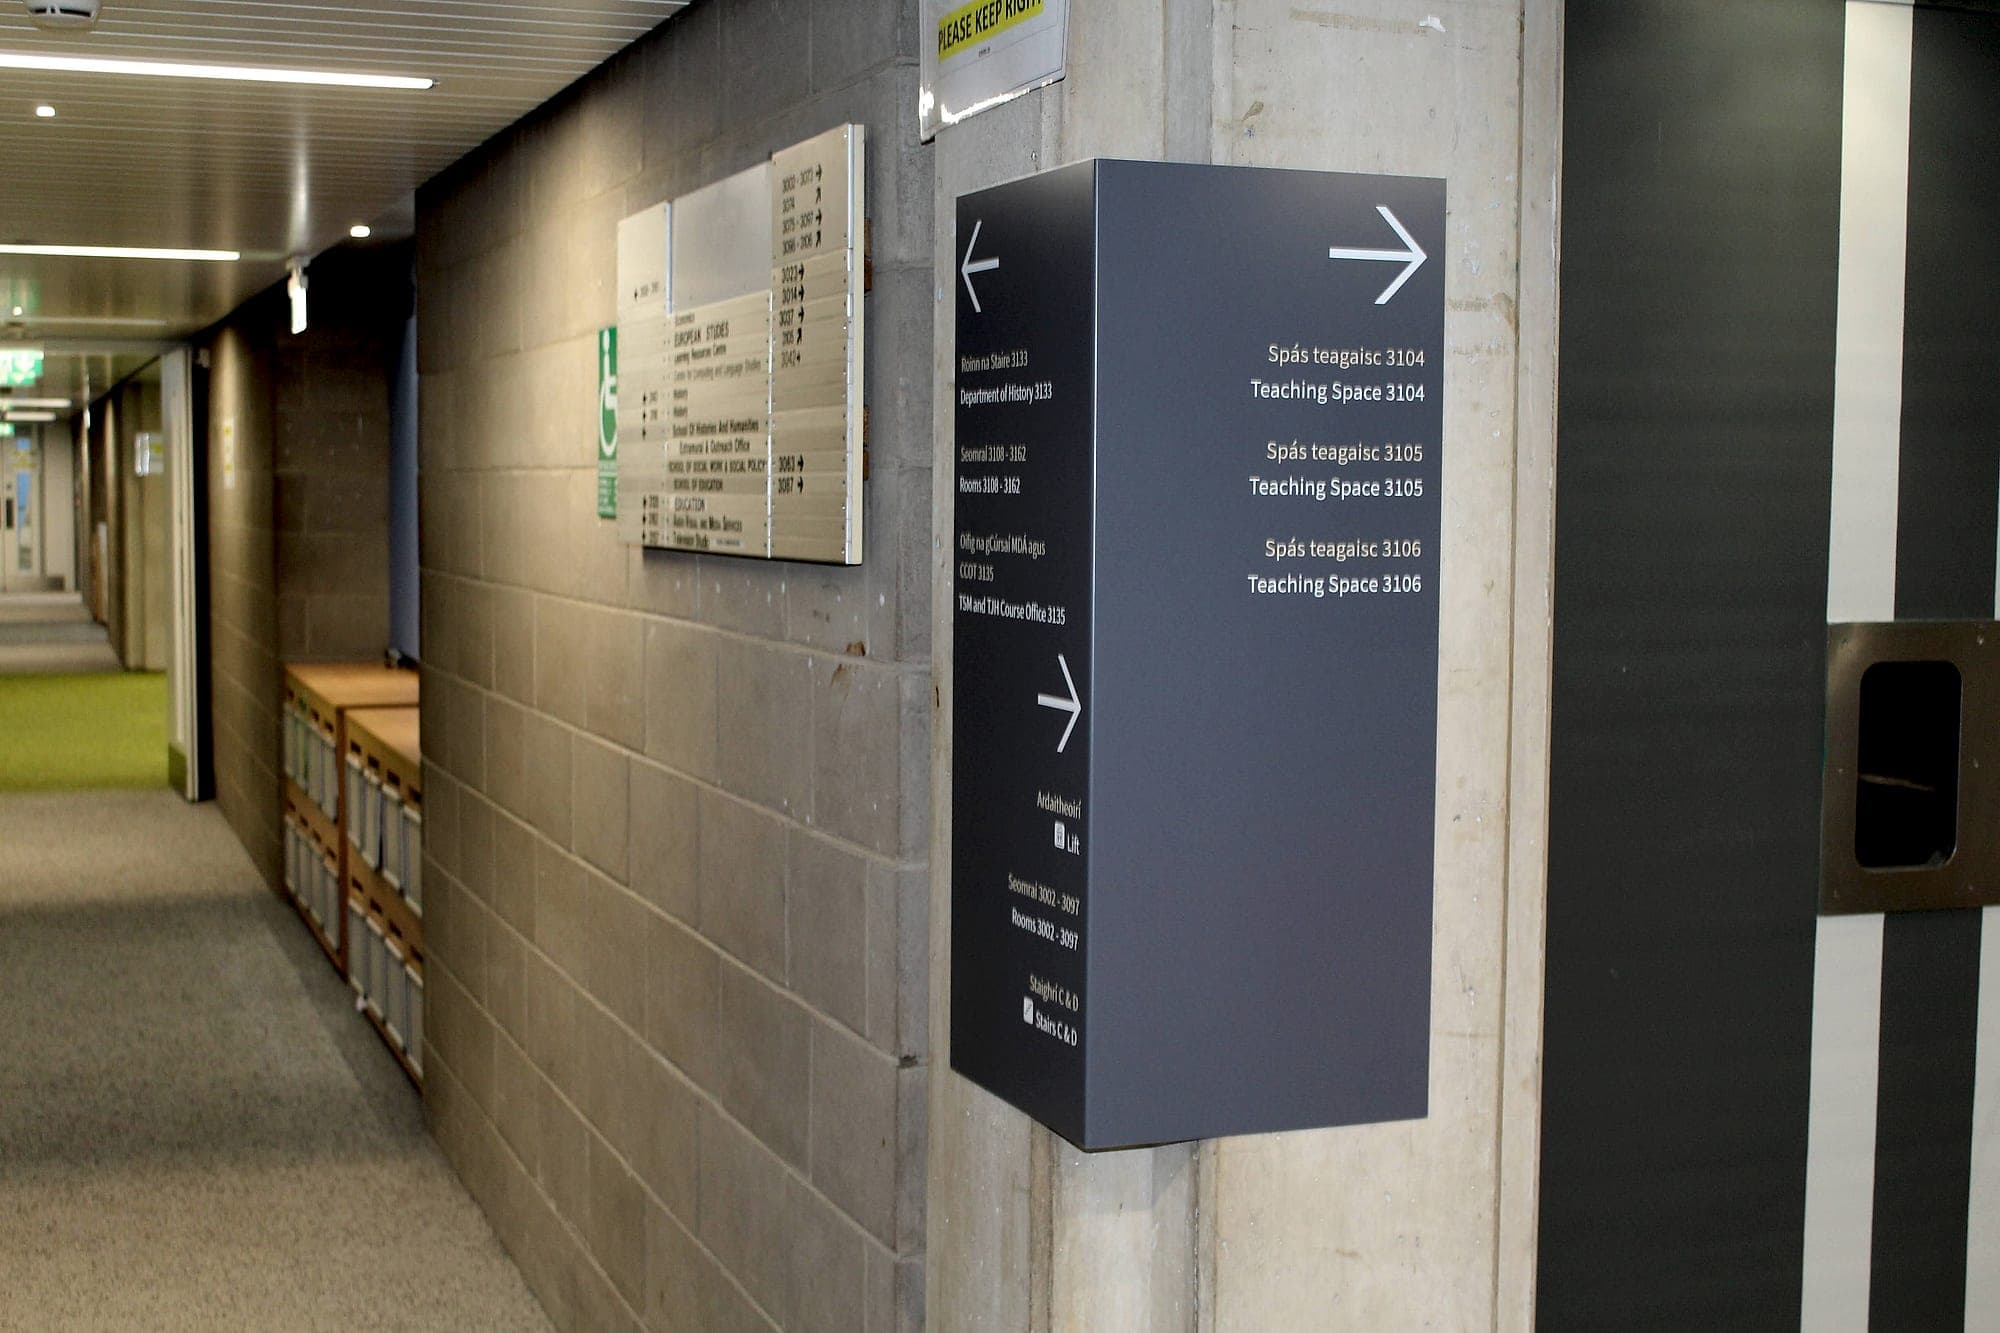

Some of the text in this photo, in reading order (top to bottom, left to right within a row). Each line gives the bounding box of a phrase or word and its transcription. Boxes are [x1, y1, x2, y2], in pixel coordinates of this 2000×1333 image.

[938, 0, 1041, 55] PLEASE KEEP RIG
[674, 321, 730, 348] EUROPEAN STUDIES
[961, 355, 981, 373] Roinn
[981, 358, 990, 371] na
[1011, 350, 1029, 368] 3133
[1268, 342, 1425, 369] Spás teagaisc 3104
[960, 381, 1053, 408] Department of History 3133
[1250, 379, 1425, 404] Teaching Space 3104
[988, 446, 1005, 463] 3108
[1009, 445, 1027, 463] 3162
[1266, 439, 1423, 465] Spás teagaisc 3105
[959, 475, 982, 494] Rooms
[982, 477, 999, 494] 3108
[1003, 477, 1021, 495] 3162
[1249, 476, 1423, 501] Teaching Space 3105
[674, 496, 706, 512] EDUCATION
[959, 531, 976, 554] Oifig
[976, 538, 985, 552] na
[1011, 533, 1028, 555] MDÁ
[1028, 541, 1046, 560] agus
[1265, 537, 1421, 562] Spás teagaisc 3106
[959, 560, 994, 582] CCOT 3135
[1248, 573, 1422, 598] Teaching Space 3106
[959, 593, 1066, 625] TSM and TJH Course Office 3135
[1036, 789, 1082, 820] Ardaitheoirí
[1067, 831, 1081, 856] Lift
[1038, 885, 1056, 908] 3002
[1062, 893, 1081, 916] 3097
[1011, 906, 1037, 934] Rooms
[1037, 918, 1055, 942] 3002
[1060, 928, 1079, 951] 3097
[1058, 986, 1065, 1006] C
[1065, 990, 1072, 1010] &
[1072, 994, 1079, 1012] D
[1035, 1009, 1078, 1047] Stairs C & D
